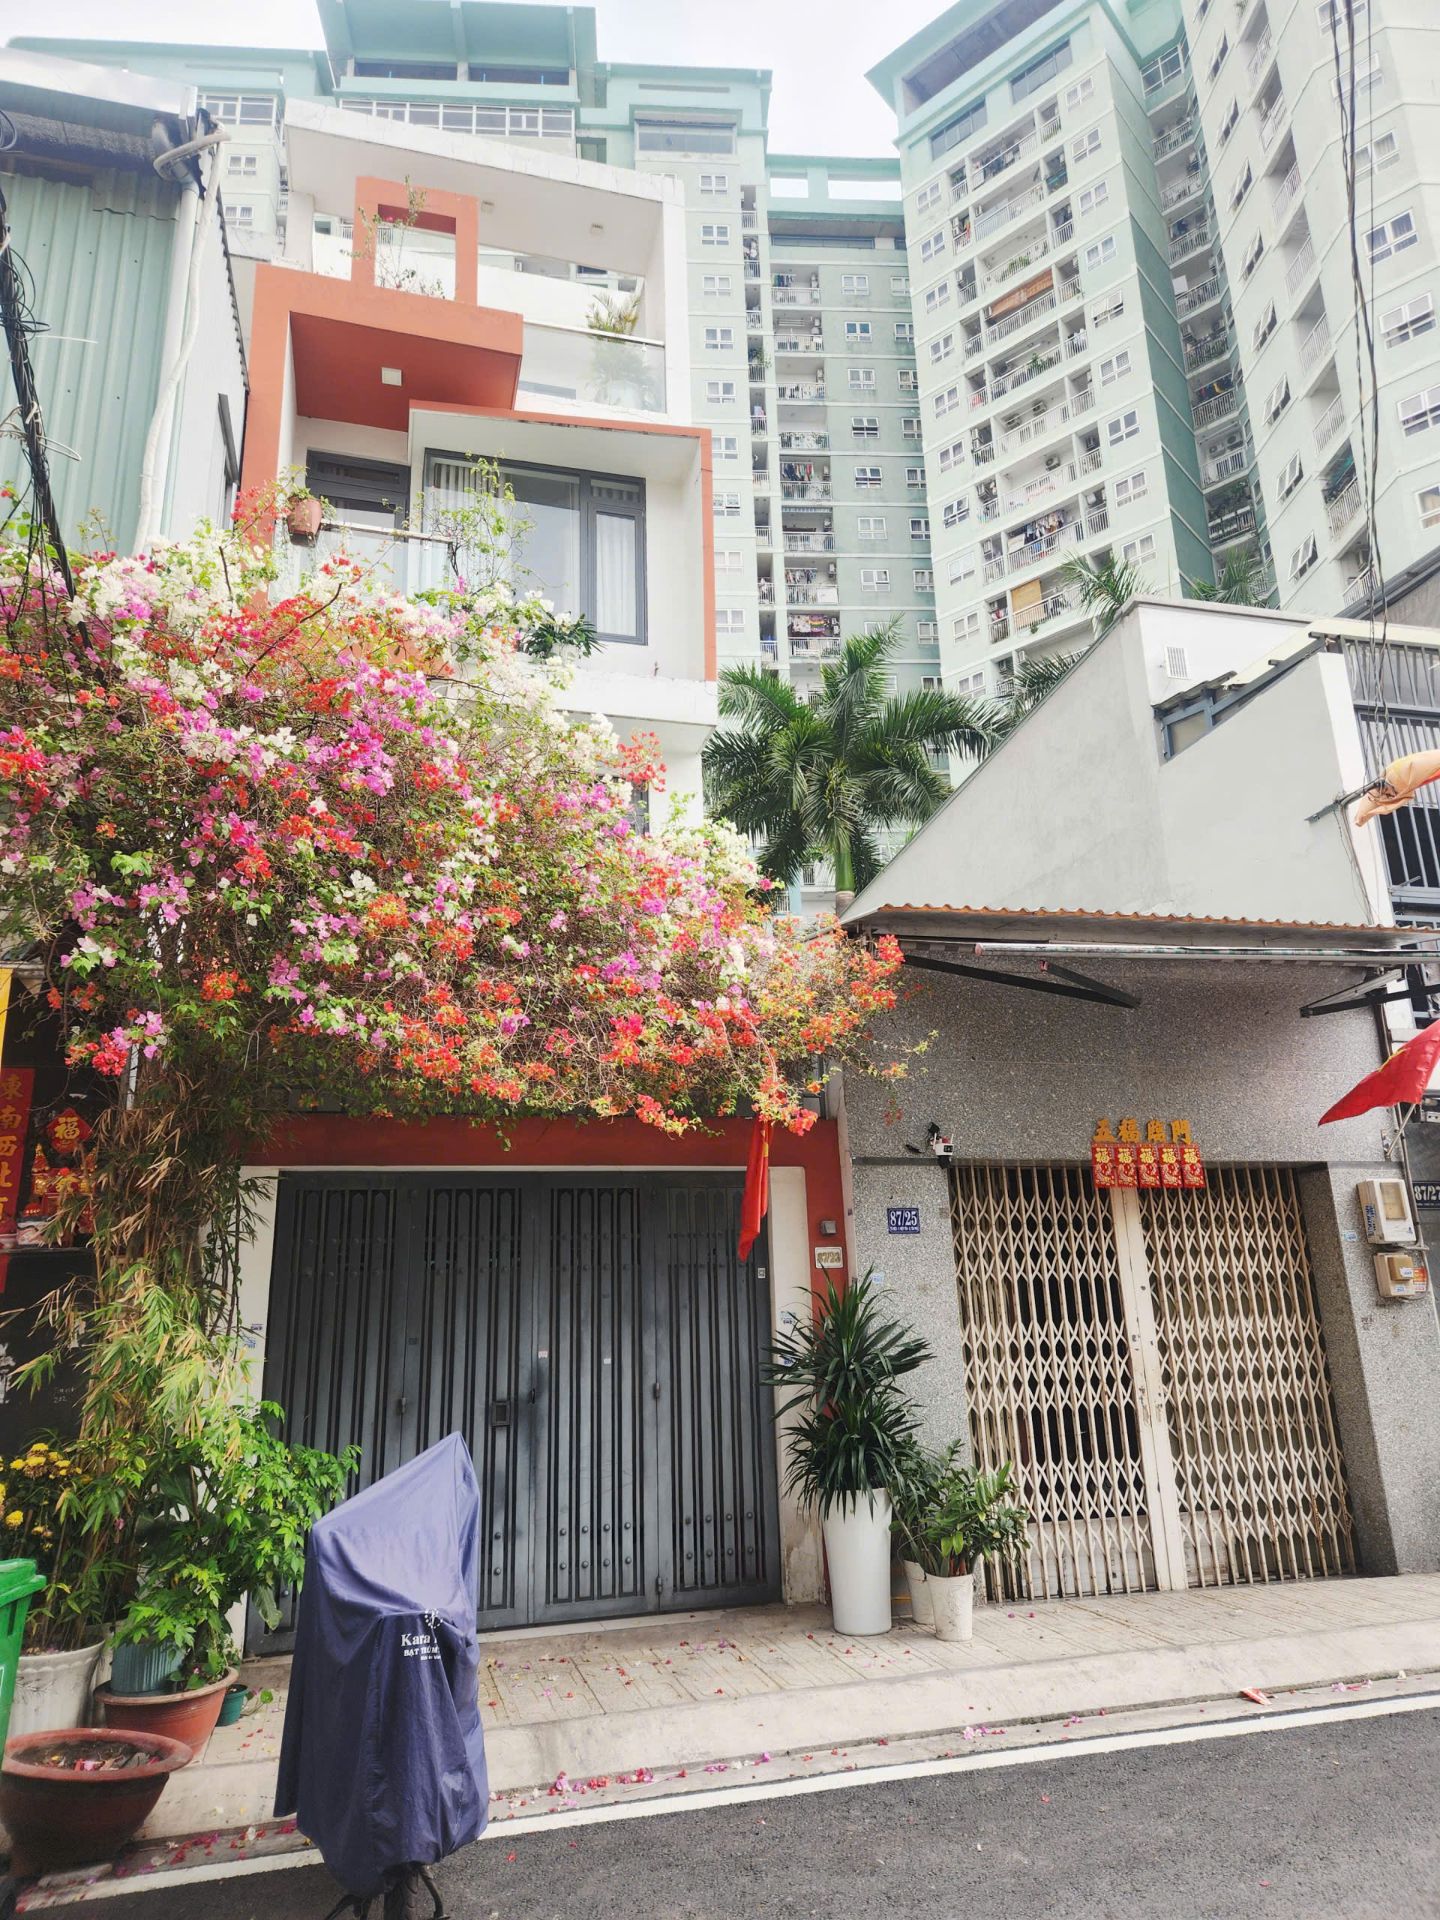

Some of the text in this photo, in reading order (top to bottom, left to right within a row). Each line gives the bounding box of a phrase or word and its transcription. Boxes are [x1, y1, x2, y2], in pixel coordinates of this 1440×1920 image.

[54, 1116, 80, 1139] 福
[1092, 1118, 1192, 1145] 五福臨門
[1095, 1147, 1110, 1164] 福
[1117, 1147, 1132, 1164] 福
[1139, 1147, 1154, 1164] 福
[1162, 1147, 1177, 1164] 福
[1183, 1147, 1198, 1164] 福
[890, 1211, 917, 1226] 87/25
[401, 1633, 430, 1646] Kara
[404, 1648, 419, 1657] BẠT
